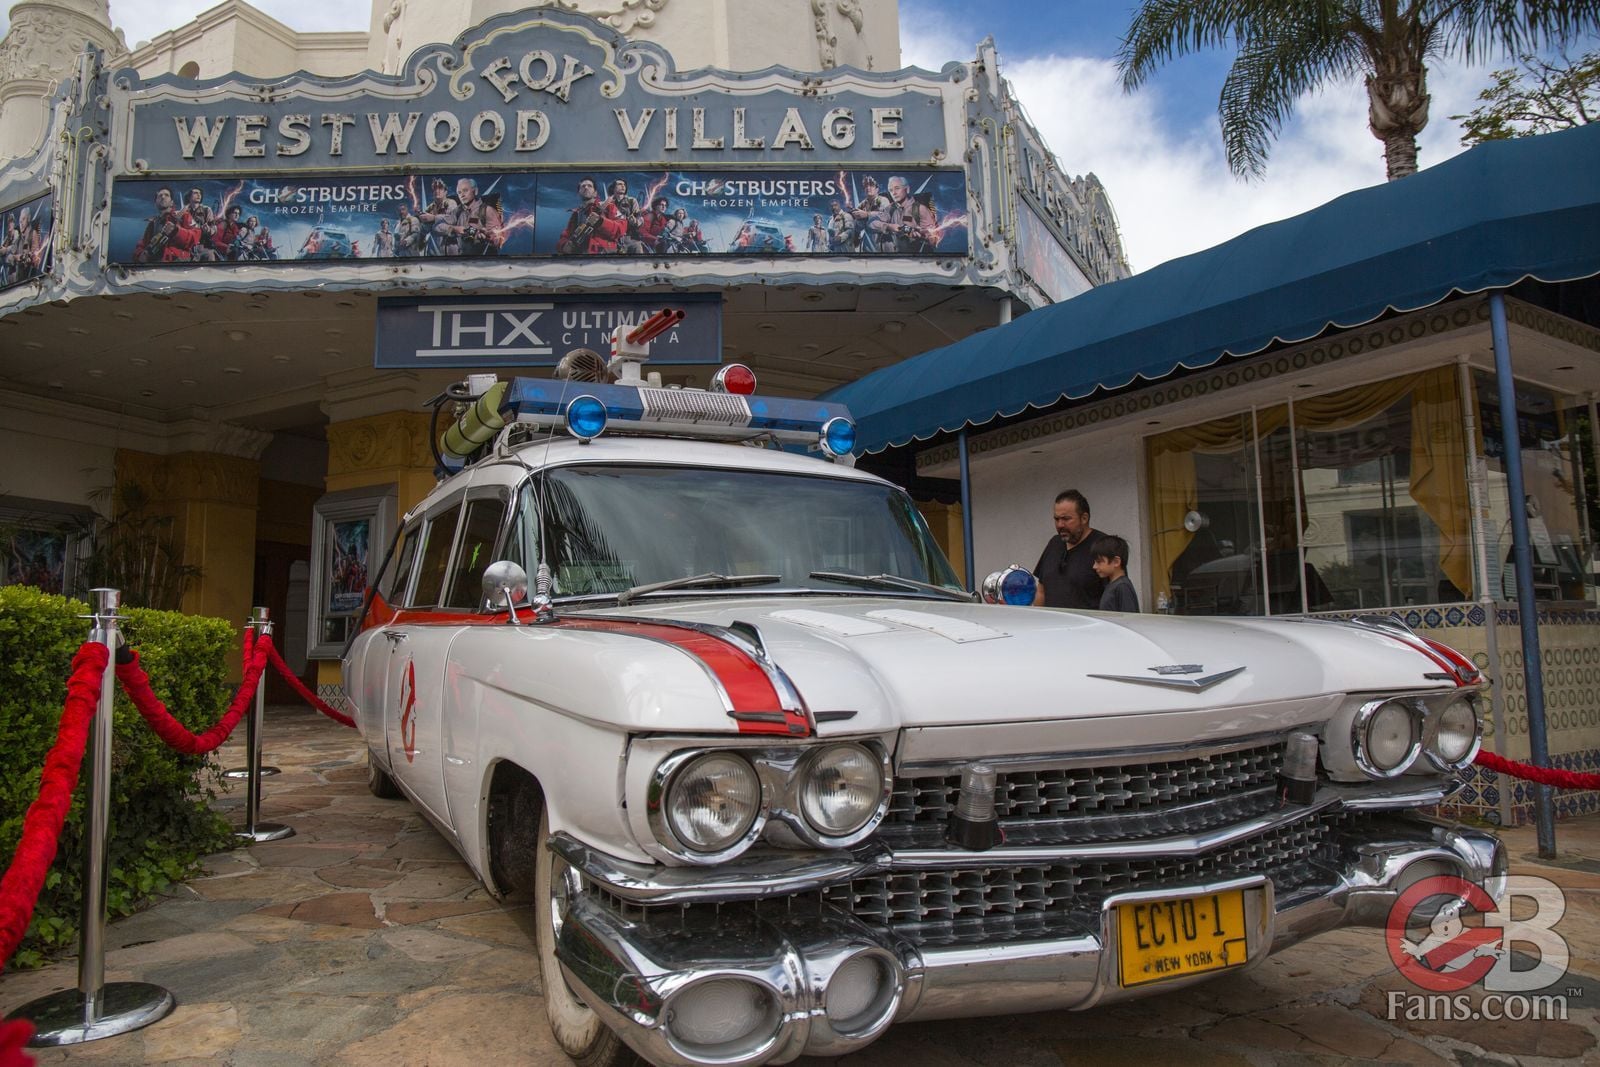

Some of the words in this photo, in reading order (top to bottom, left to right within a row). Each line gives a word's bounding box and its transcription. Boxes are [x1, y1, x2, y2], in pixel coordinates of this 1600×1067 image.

[481, 49, 595, 103] FOX
[173, 109, 551, 159] WESTWOOD
[614, 107, 904, 150] VILLAGE
[274, 205, 324, 215] FROZEN
[331, 204, 378, 213] EMPIRE
[703, 199, 754, 207] FROZEN
[761, 199, 809, 207] EMPIRE
[417, 303, 554, 347] THX
[562, 310, 681, 329] ULTIMA
[562, 331, 680, 345] CINA
[1155, 956, 1181, 972] NEW
[1185, 951, 1213, 967] YORK
